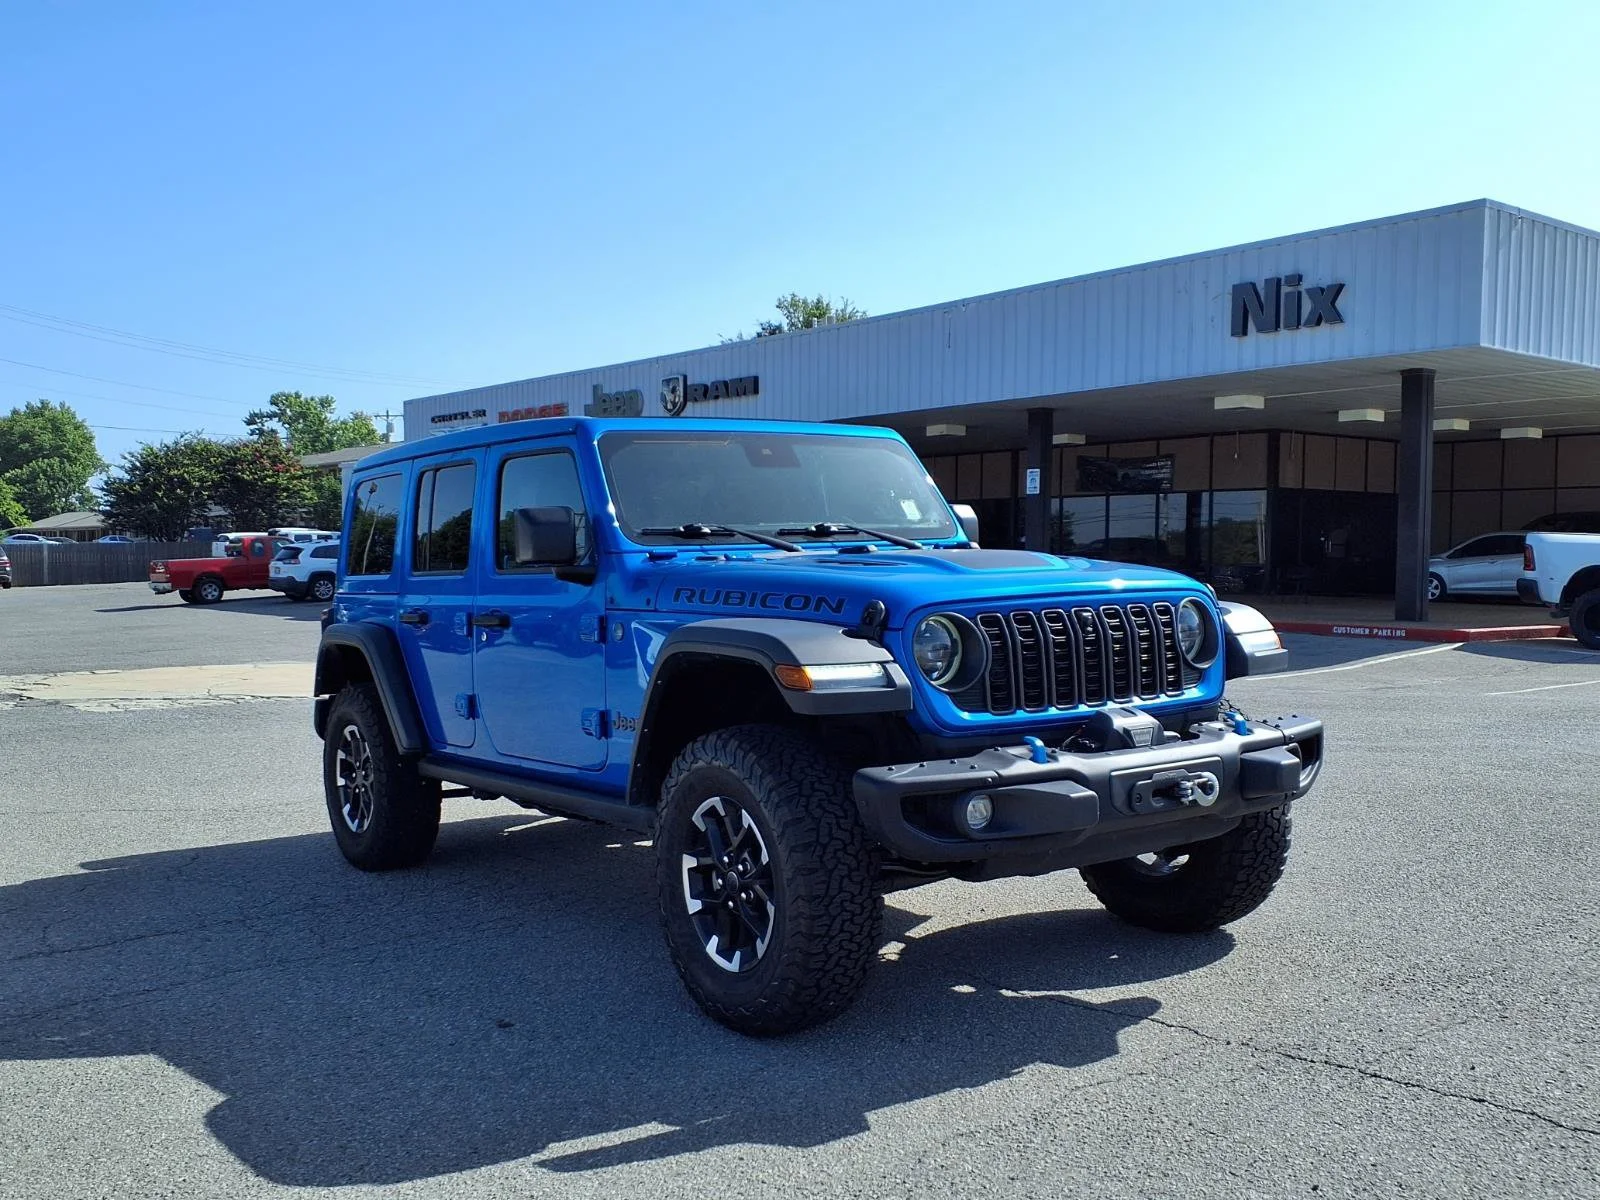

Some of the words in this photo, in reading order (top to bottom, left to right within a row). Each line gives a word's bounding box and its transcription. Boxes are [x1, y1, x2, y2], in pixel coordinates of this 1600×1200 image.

[1231, 273, 1346, 337] Nix
[584, 383, 644, 417] Jeep
[686, 375, 760, 403] RAM
[498, 402, 569, 423] DODGE
[671, 586, 849, 616] RUBICON
[1333, 626, 1370, 635] CUSTOMER
[1373, 628, 1406, 637] PARKING
